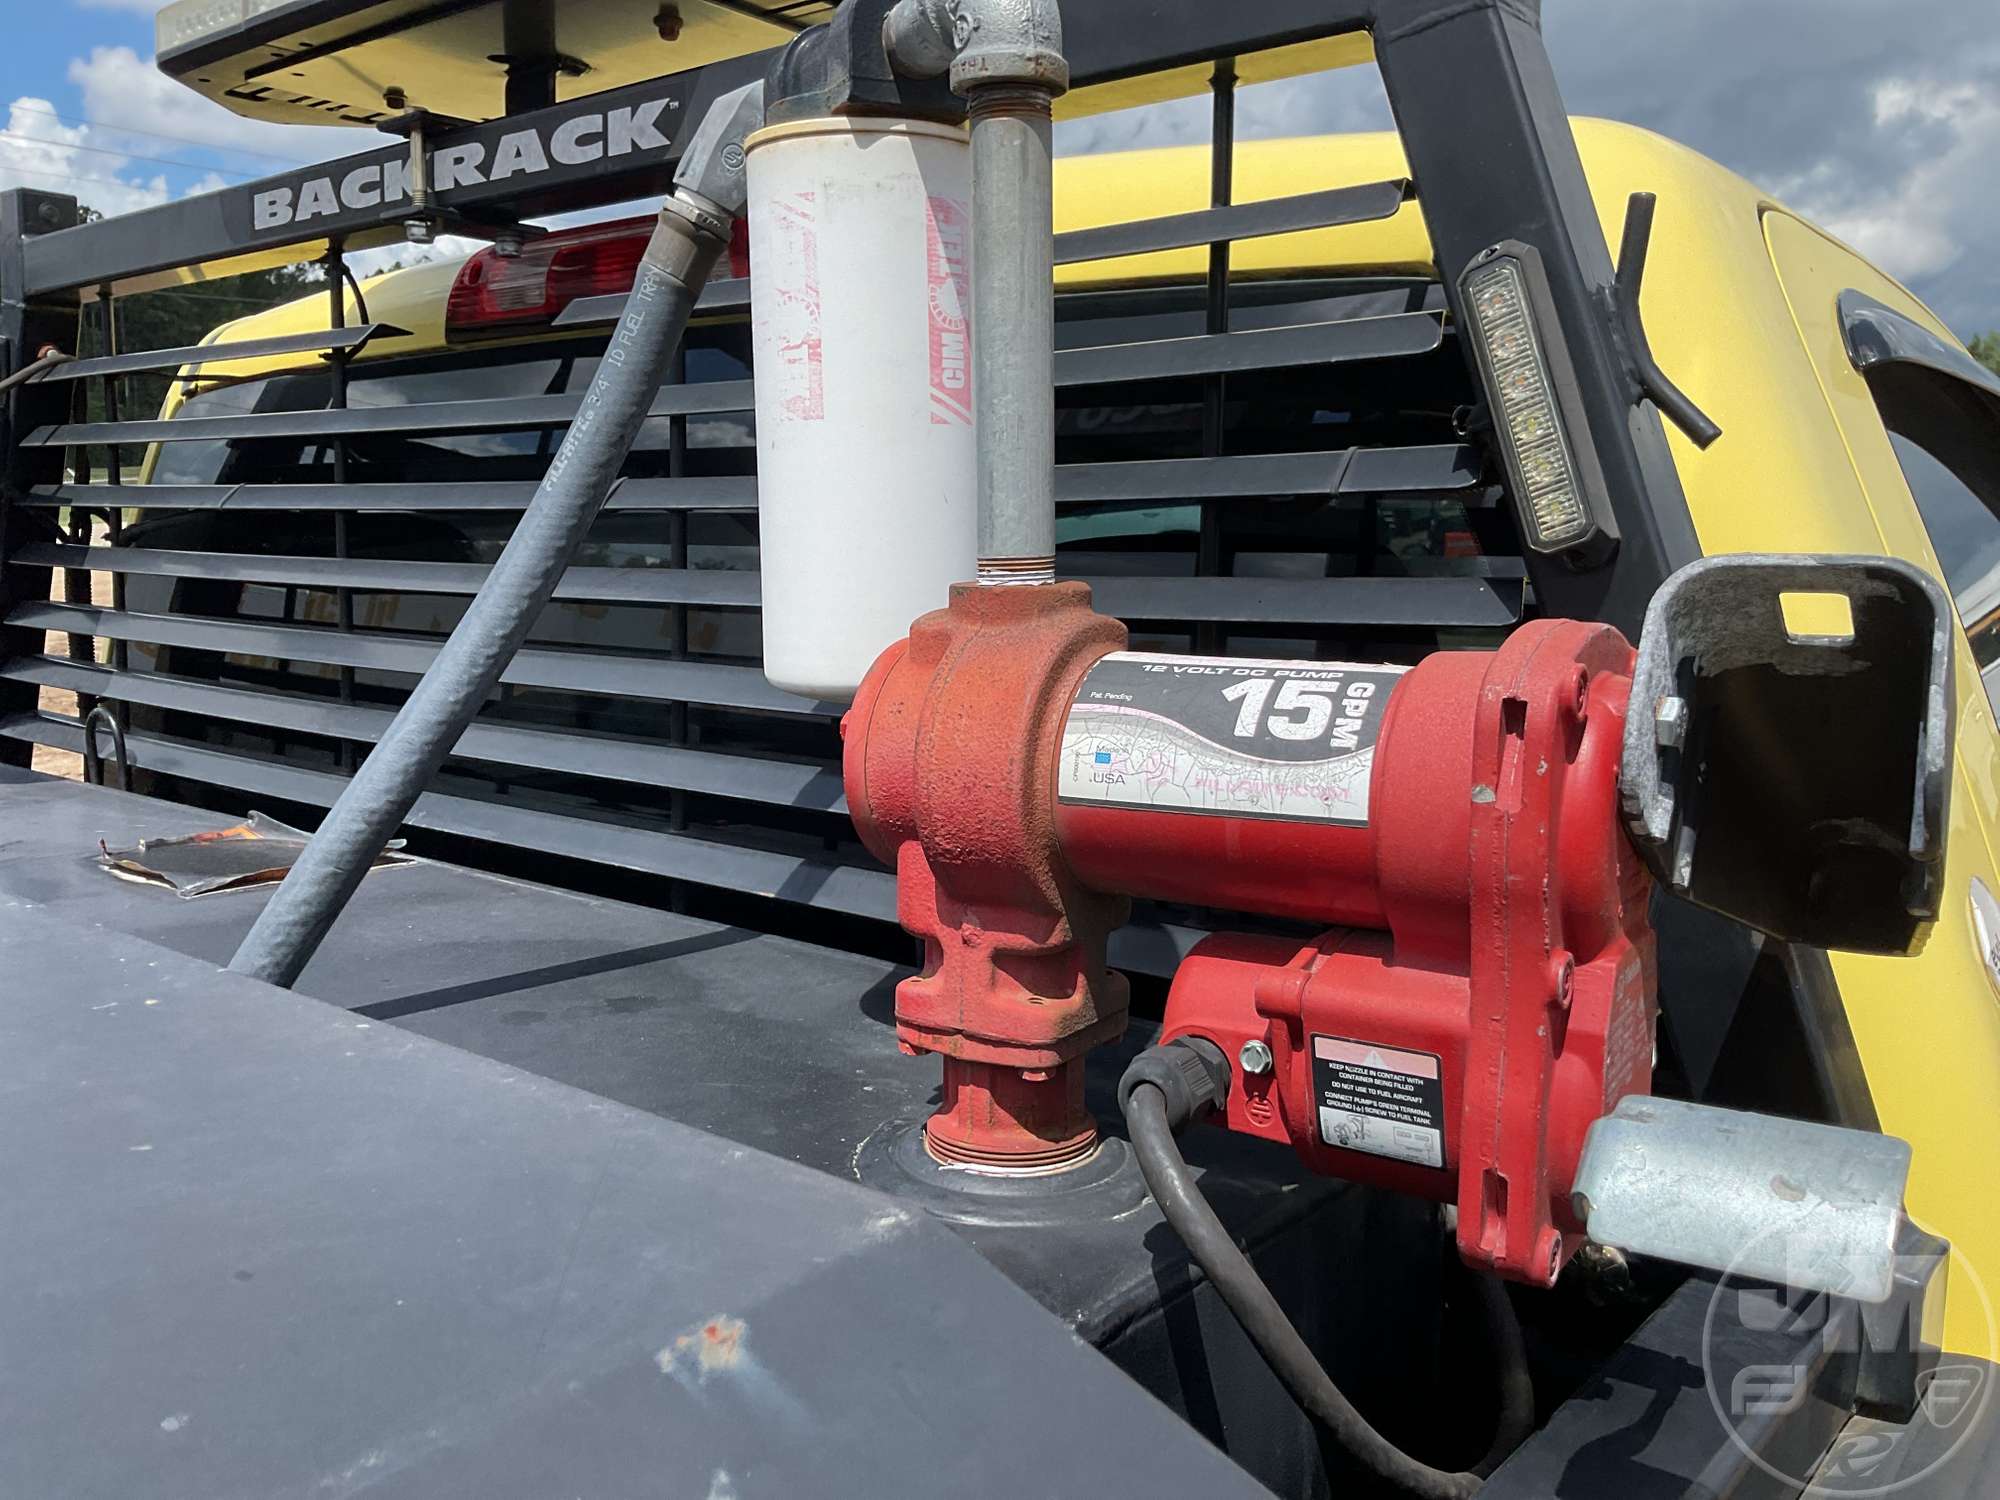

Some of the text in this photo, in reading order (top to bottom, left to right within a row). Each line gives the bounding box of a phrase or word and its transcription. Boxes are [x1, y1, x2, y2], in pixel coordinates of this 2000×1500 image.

[608, 350, 625, 367] ID
[621, 311, 645, 348] FUEL
[941, 332, 965, 389] CIM
[1142, 664, 1344, 680] 12 VOLT DC PUMP
[1104, 693, 1133, 702] Pending
[1221, 678, 1341, 741] 15
[1330, 682, 1376, 751] GPM
[1093, 772, 1126, 785] USA
[1329, 1062, 1344, 1070] KEEP
[1345, 1065, 1368, 1075] NOZZLE
[1377, 1071, 1405, 1082] CONTACT
[1406, 1077, 1424, 1085] WITH
[1339, 1072, 1414, 1091] CONTAINER BEING FILLED
[1324, 1091, 1353, 1101] CONNECT
[1378, 1101, 1399, 1111] GREEN
[1400, 1106, 1432, 1118] TERMINAL
[1342, 1083, 1354, 1091] NOT
[1355, 1085, 1367, 1093] USE
[1377, 1090, 1392, 1098] FUEL
[1393, 1093, 1422, 1104] AIRCRAFT
[1326, 1099, 1352, 1109] GROUND
[1365, 1107, 1387, 1117] SCREW
[1397, 1113, 1412, 1122] FUEL
